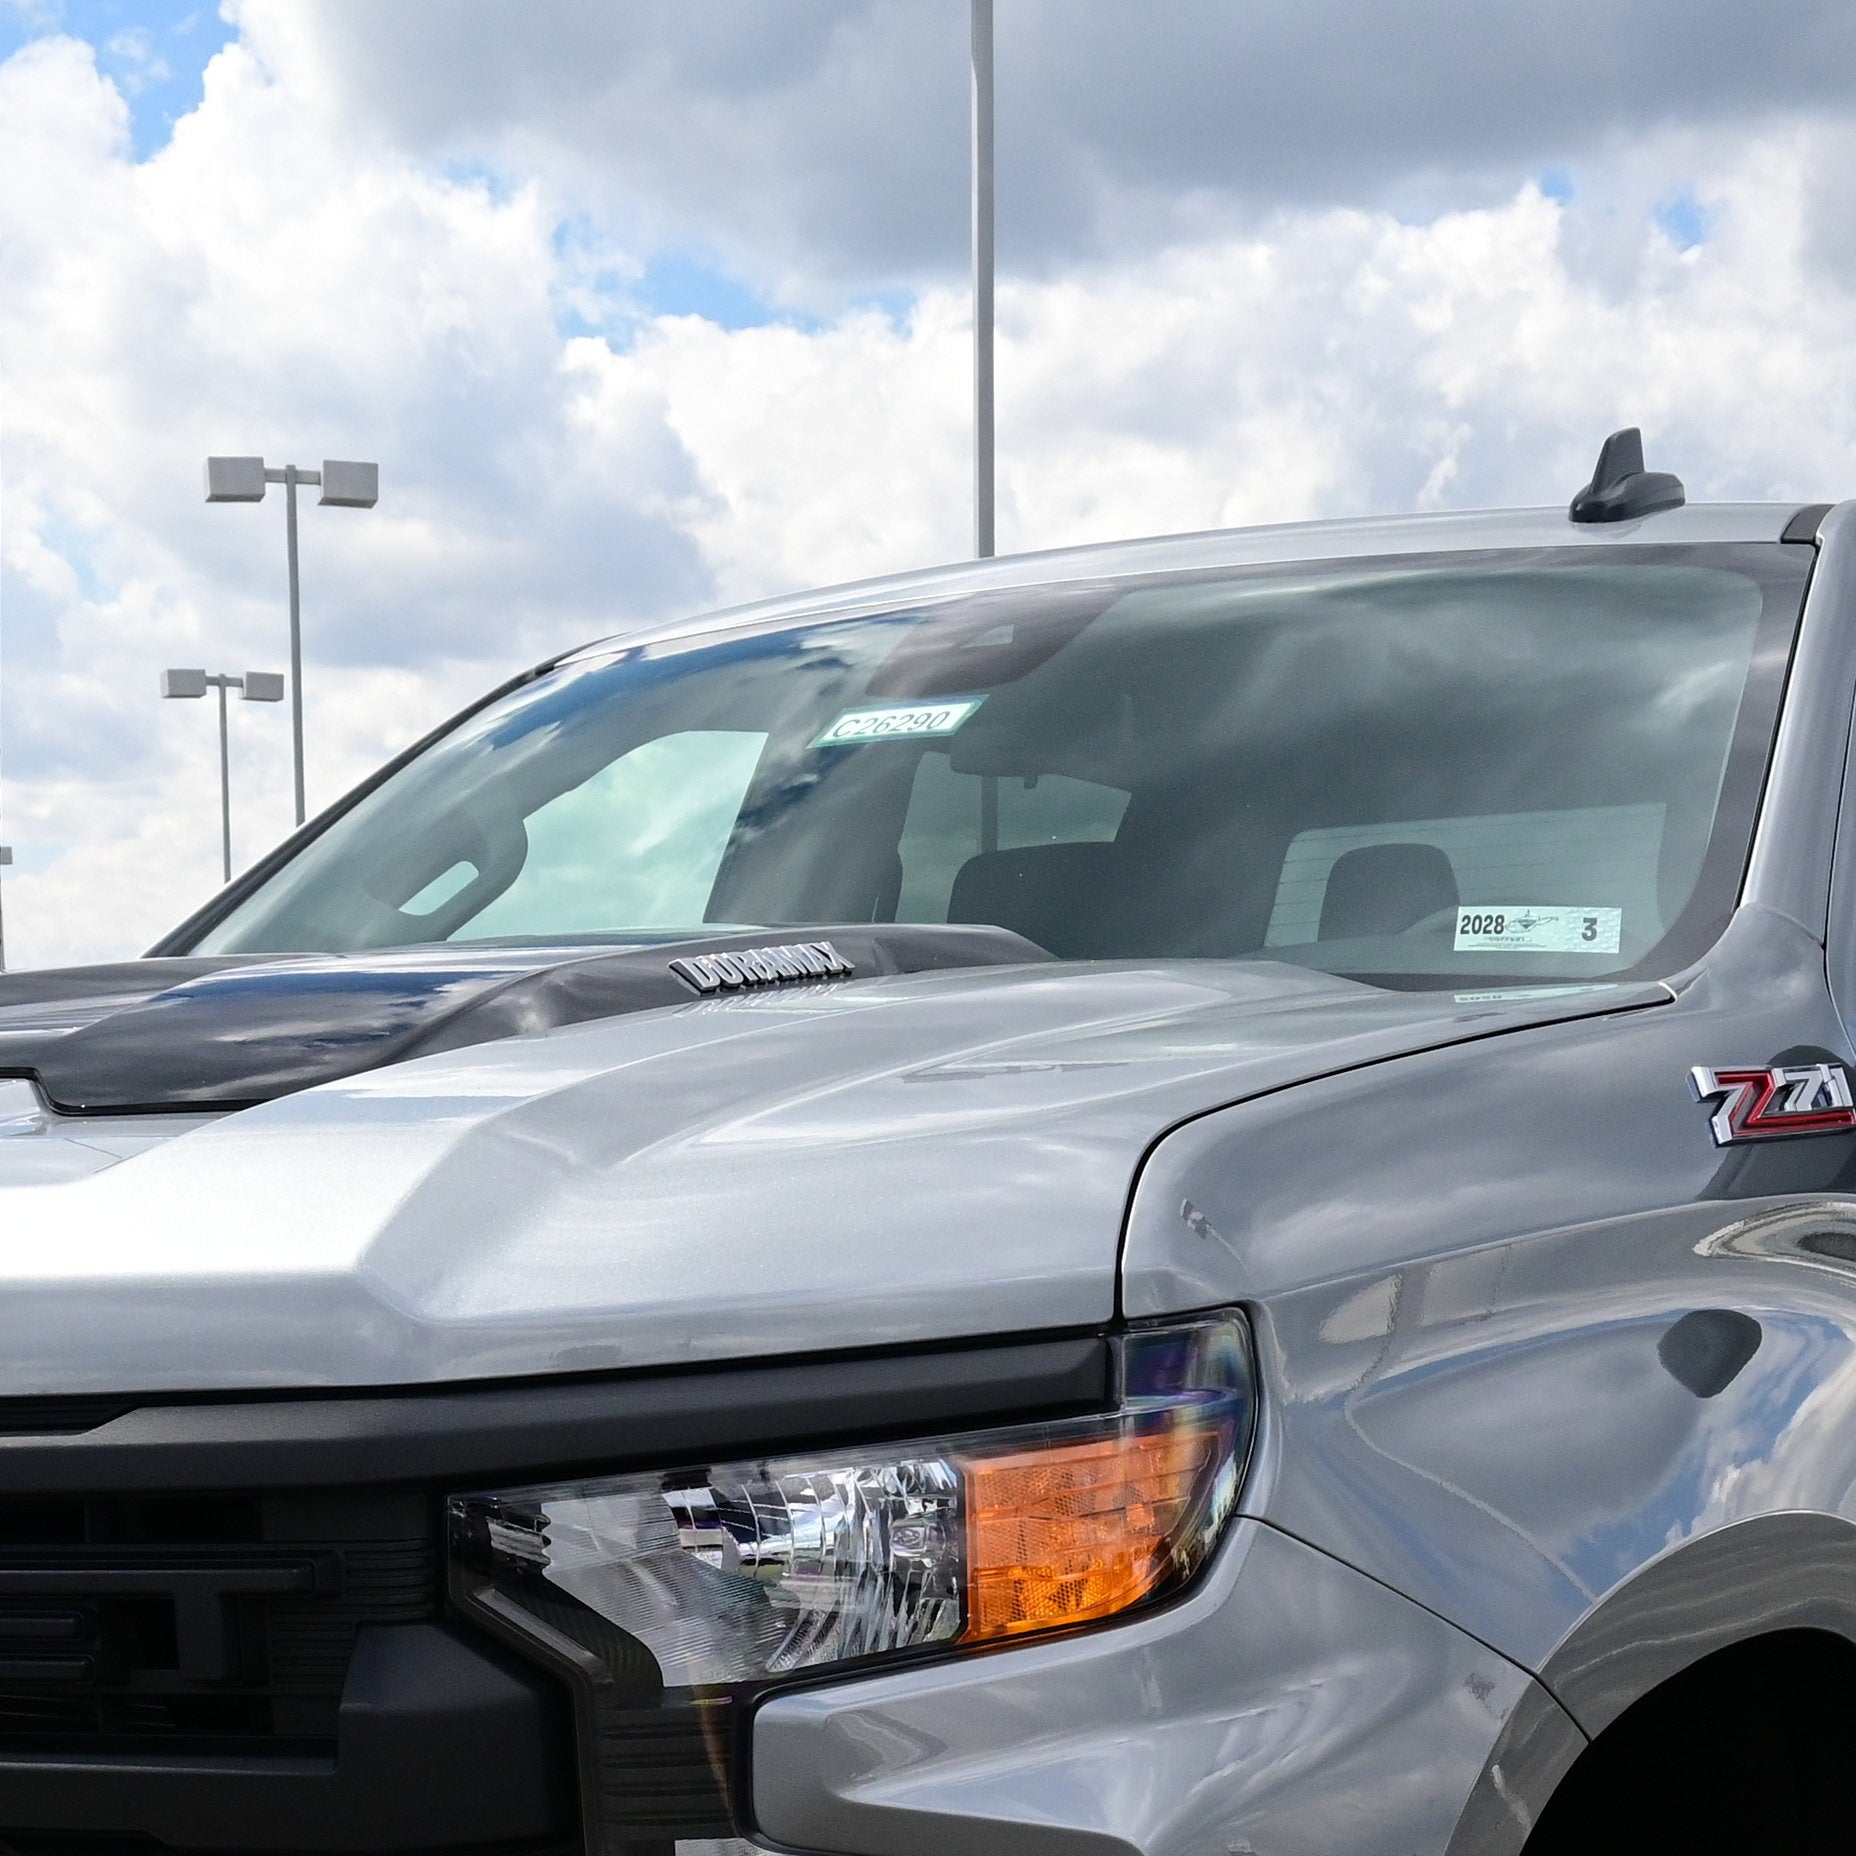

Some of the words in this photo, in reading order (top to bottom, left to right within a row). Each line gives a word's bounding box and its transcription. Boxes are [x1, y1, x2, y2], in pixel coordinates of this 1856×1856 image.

[832, 710, 951, 738] C26290
[1460, 914, 1505, 935] 2028
[1581, 917, 1598, 942] 3
[667, 941, 857, 993] DURAMAX
